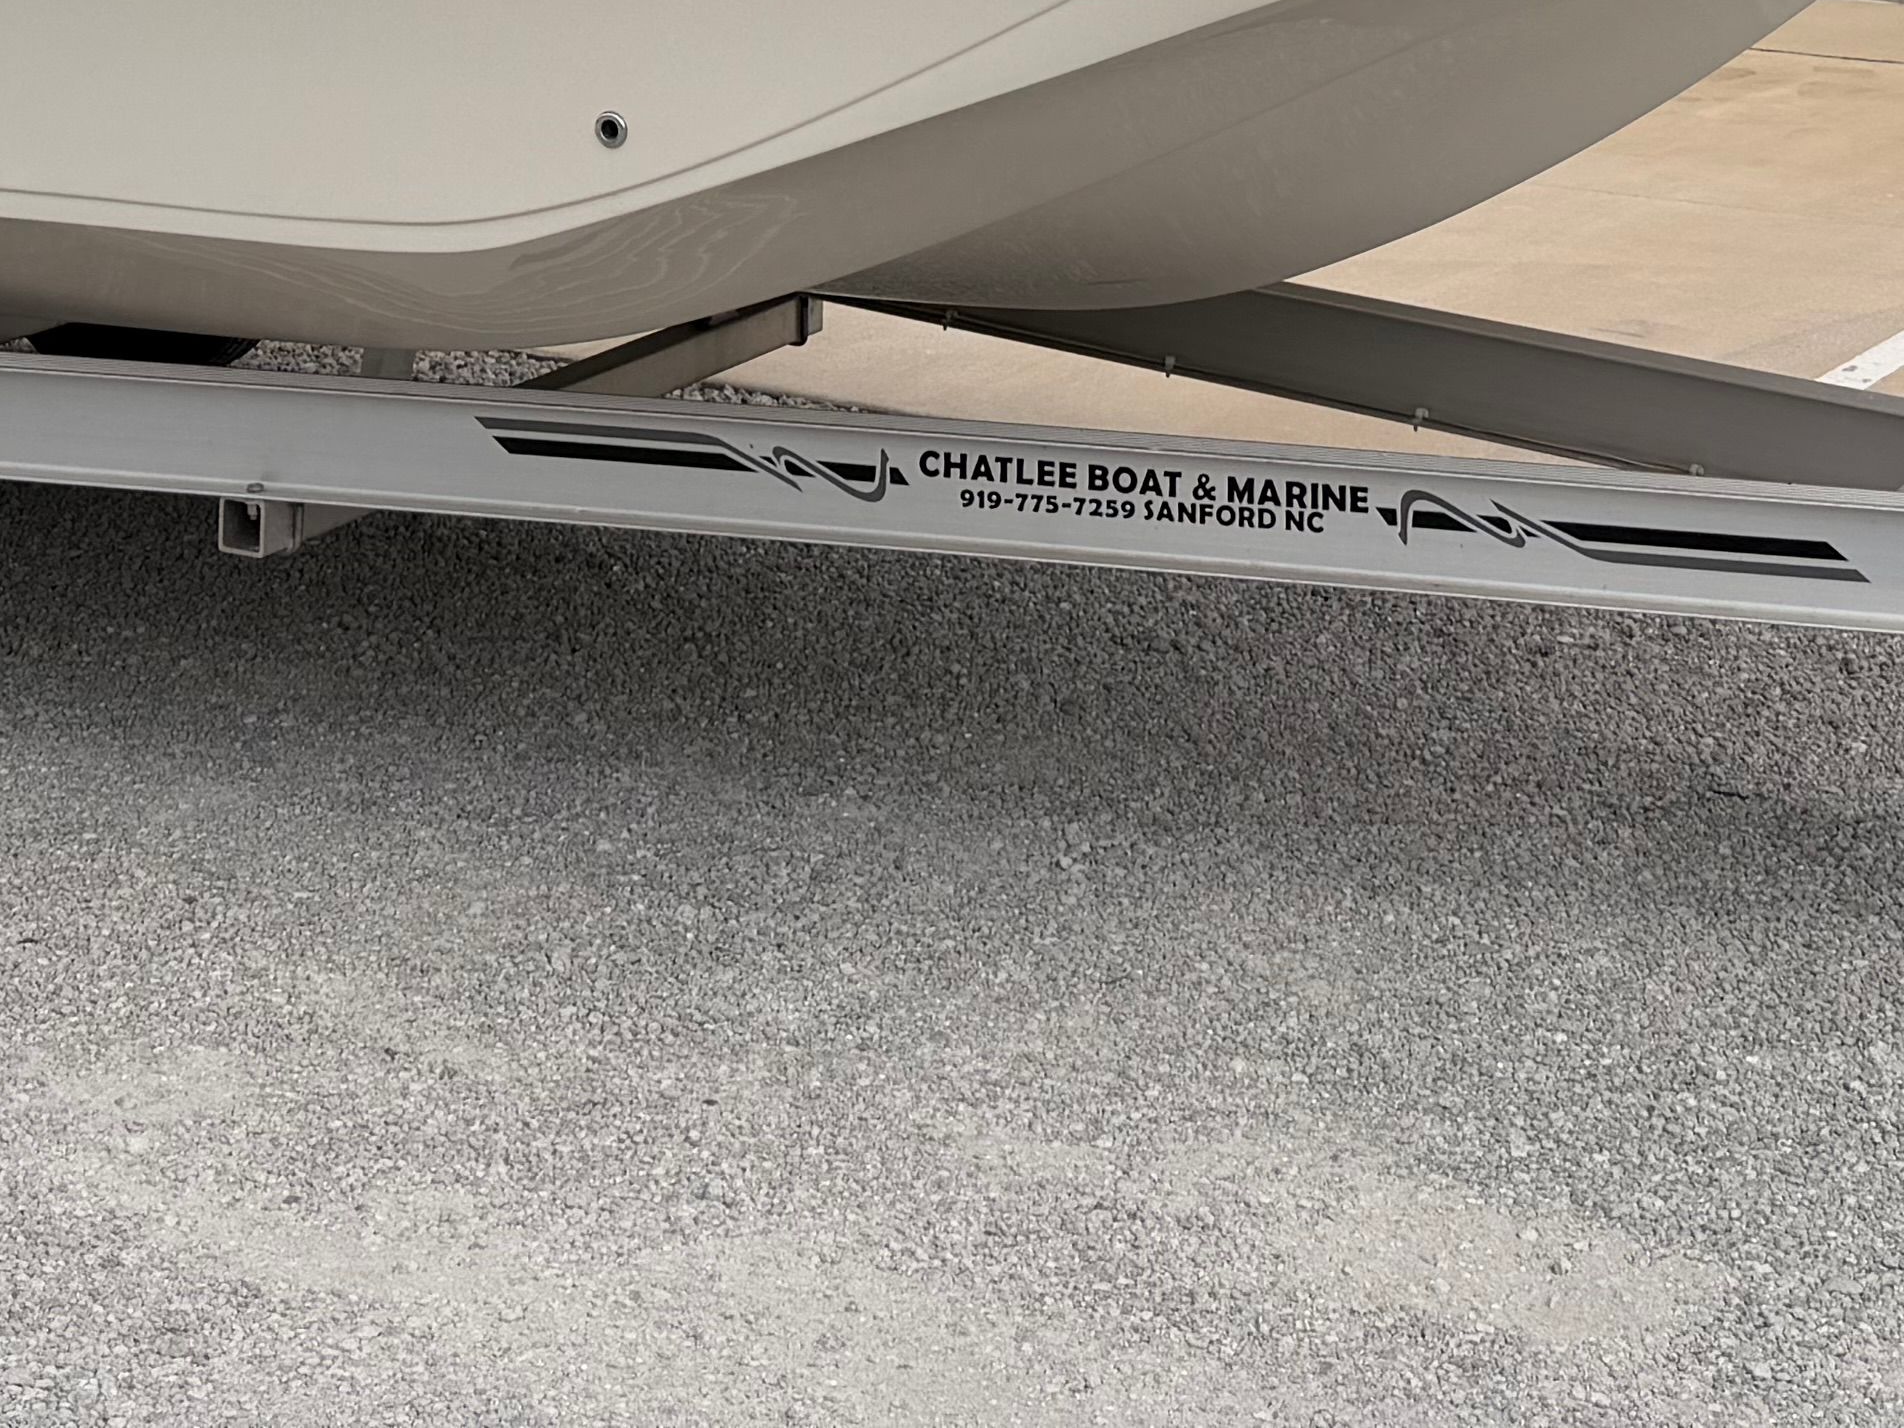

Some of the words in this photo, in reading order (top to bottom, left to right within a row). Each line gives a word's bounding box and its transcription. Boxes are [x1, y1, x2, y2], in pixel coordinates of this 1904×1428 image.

[919, 450, 1078, 489] CHATLEE
[1087, 463, 1182, 497] BOAT
[1192, 473, 1217, 501] &
[1227, 476, 1369, 513] MARINE
[960, 489, 1136, 519] 919-775-7259
[1144, 499, 1277, 529] SANFORD
[1285, 510, 1325, 533] NC
